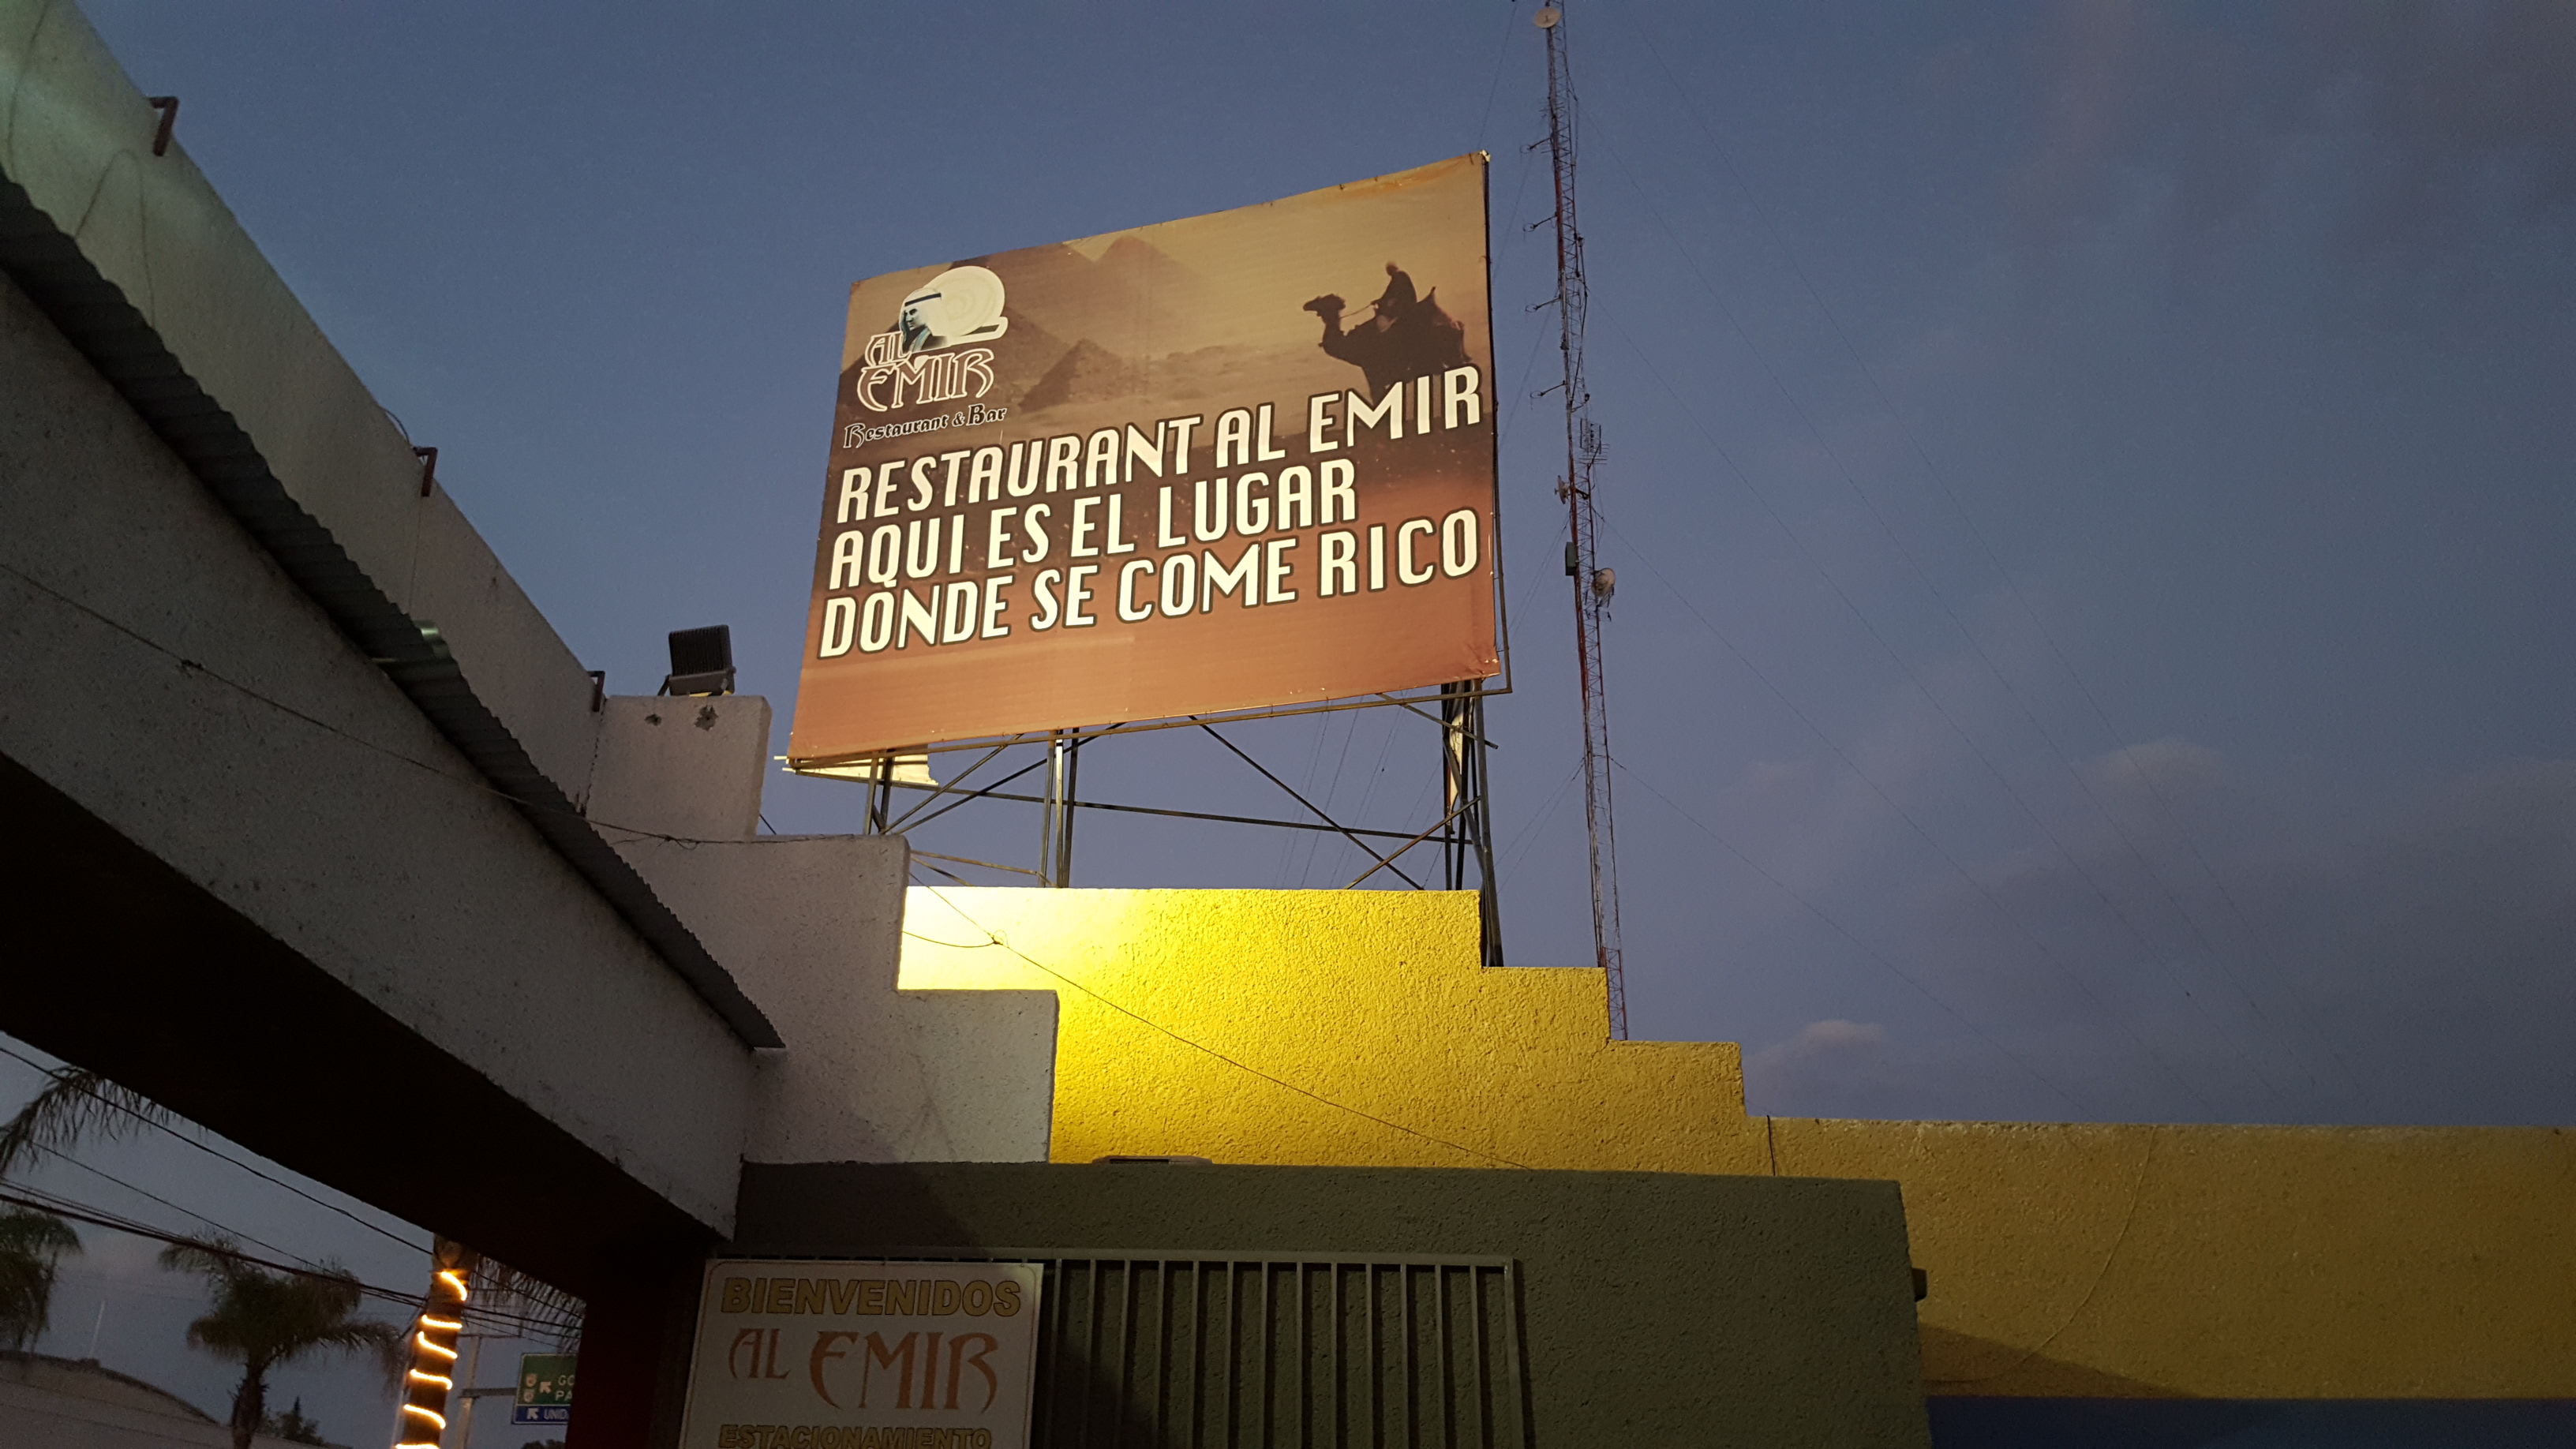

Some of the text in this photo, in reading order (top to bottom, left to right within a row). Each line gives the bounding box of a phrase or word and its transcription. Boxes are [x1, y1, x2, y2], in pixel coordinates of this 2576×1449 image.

[856, 348, 994, 412] EMIR
[865, 331, 912, 367] AL
[836, 365, 1481, 524] RESTAURANT AL EMIR
[843, 403, 1007, 448] Restaurant & Bar
[829, 458, 1356, 590] AQUI ES EL LUGAR
[818, 509, 1477, 657] DONDE SE COME RICO
[720, 1276, 1022, 1317] BIENVENIDOS
[728, 1327, 1000, 1414] AL EMIR
[717, 1424, 993, 1449] ESTACIONAMIENTO
